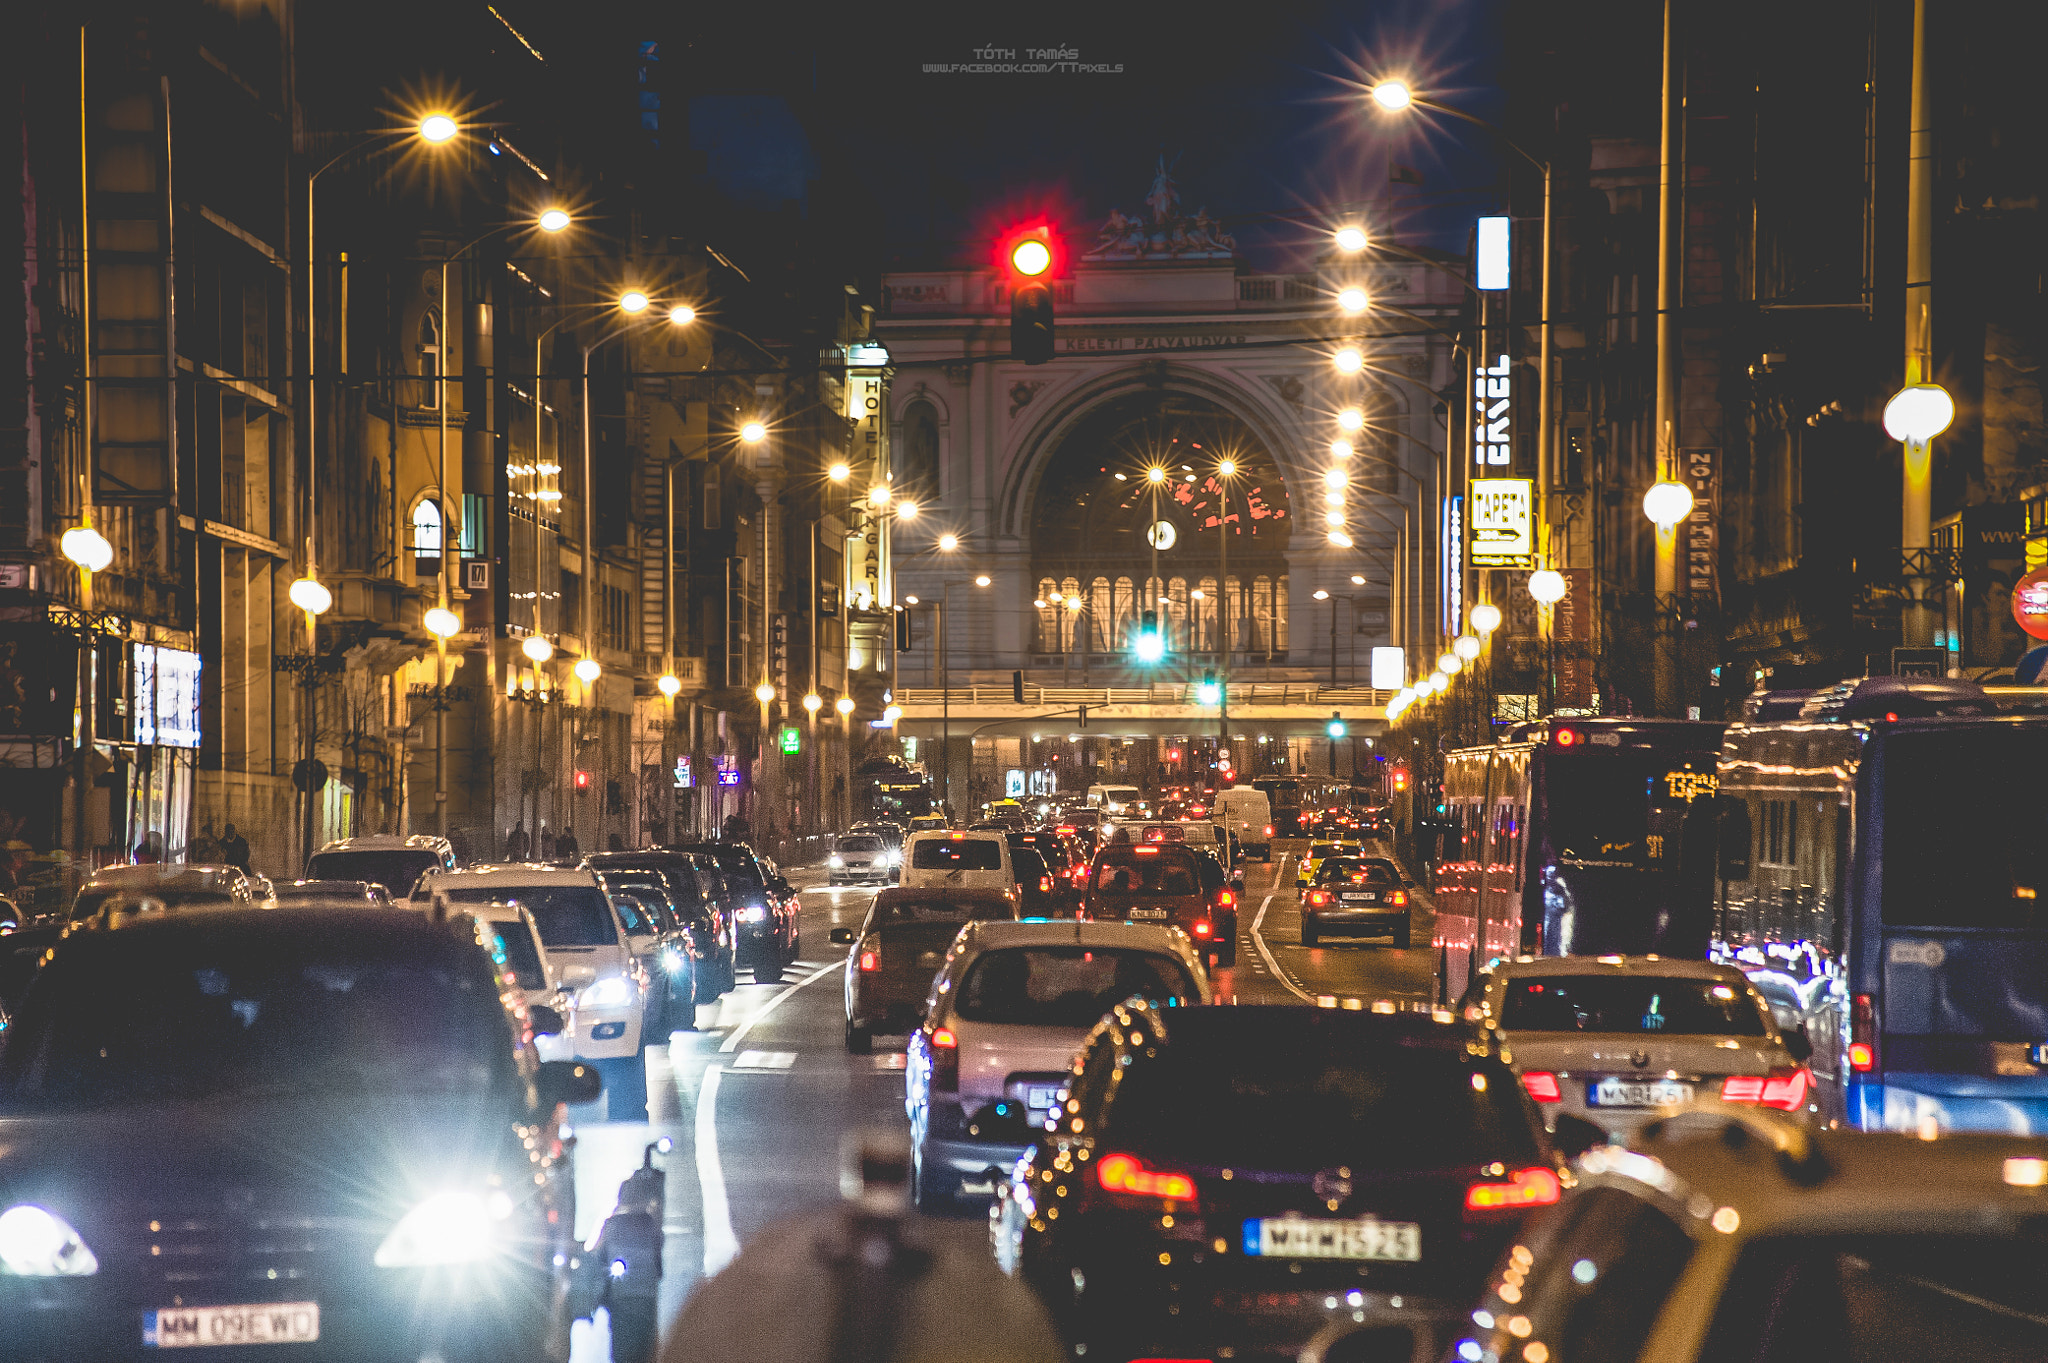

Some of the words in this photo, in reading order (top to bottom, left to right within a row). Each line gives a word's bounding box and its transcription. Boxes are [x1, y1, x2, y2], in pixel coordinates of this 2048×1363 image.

[1066, 338, 1123, 350] KELETI
[865, 381, 878, 460] HOTEL
[1475, 493, 1527, 523] TAPETA
[471, 565, 486, 582] R70
